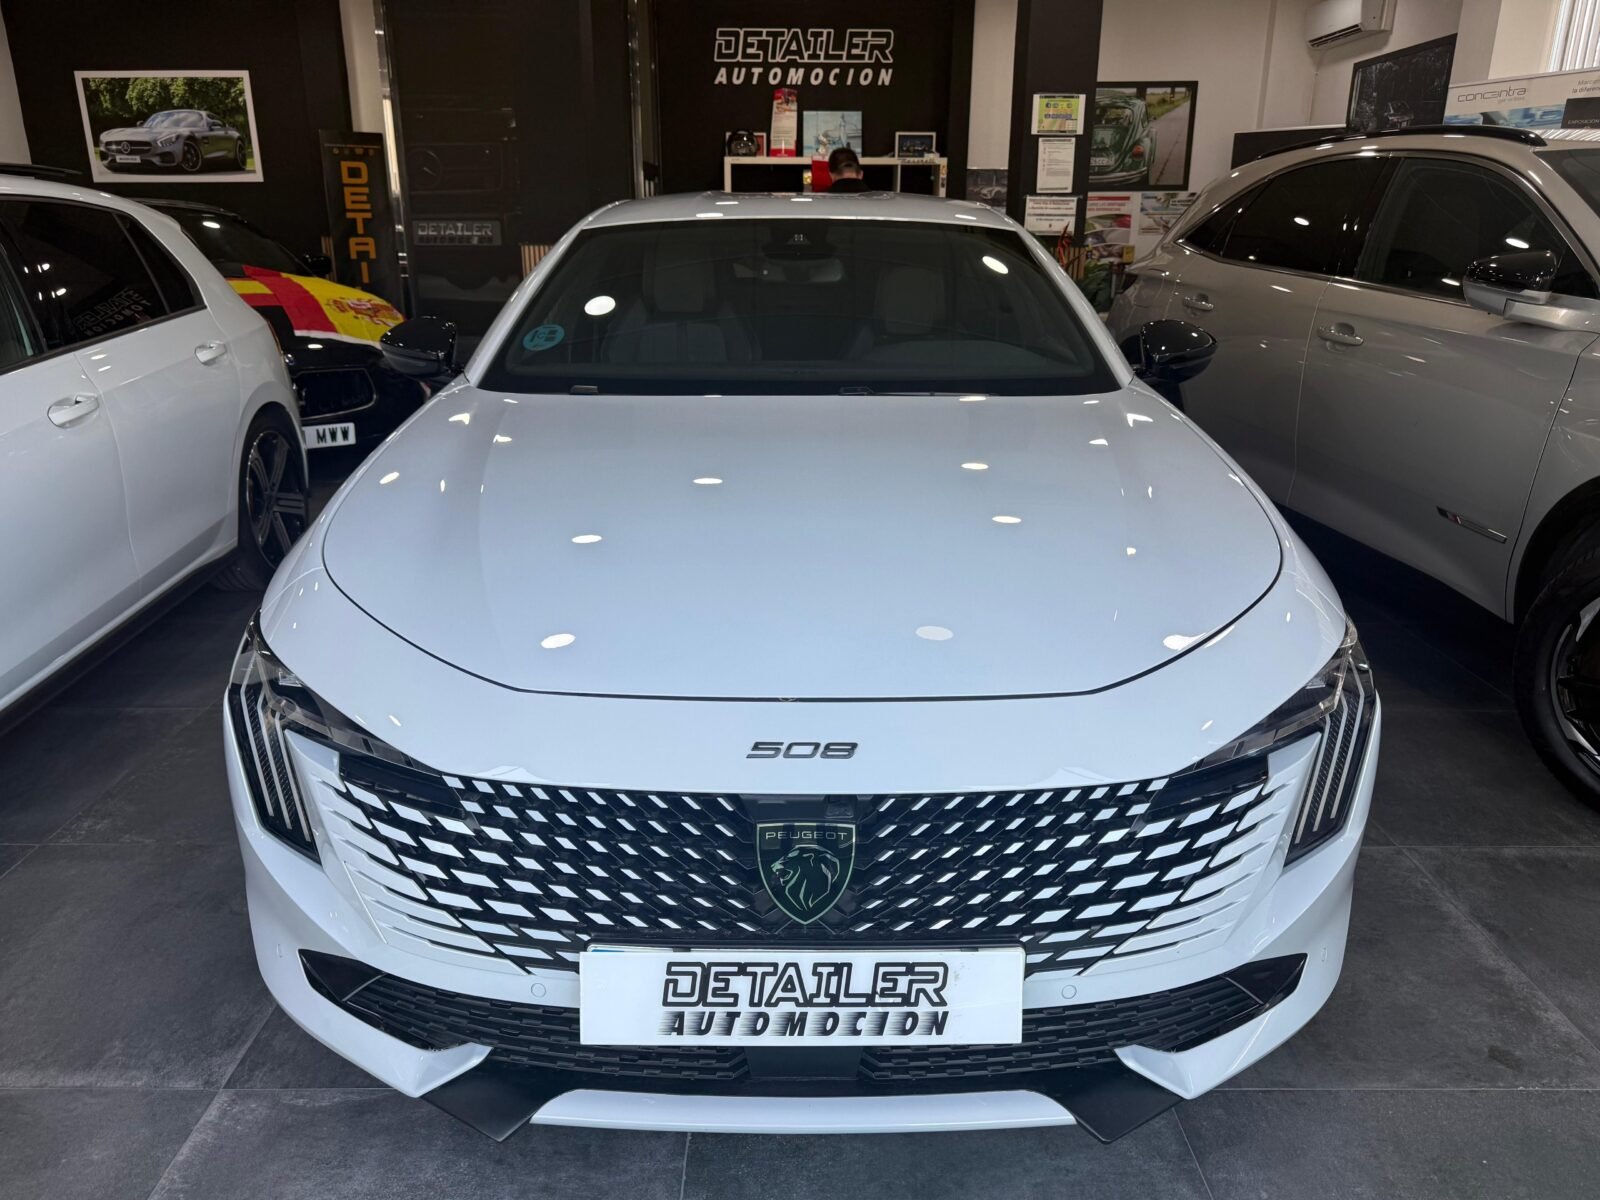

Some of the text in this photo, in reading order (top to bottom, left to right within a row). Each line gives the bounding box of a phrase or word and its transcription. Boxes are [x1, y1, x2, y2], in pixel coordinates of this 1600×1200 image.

[714, 28, 894, 63] DETAILER
[714, 67, 893, 86] AUTOMOCION
[340, 160, 377, 290] DETAI
[418, 223, 493, 236] DETAILER
[316, 425, 350, 445] MWW
[746, 742, 858, 759] 508
[765, 831, 848, 841] PEUGEOT
[662, 962, 949, 1007] DETAILER
[657, 1011, 949, 1036] AUTOMOCION
